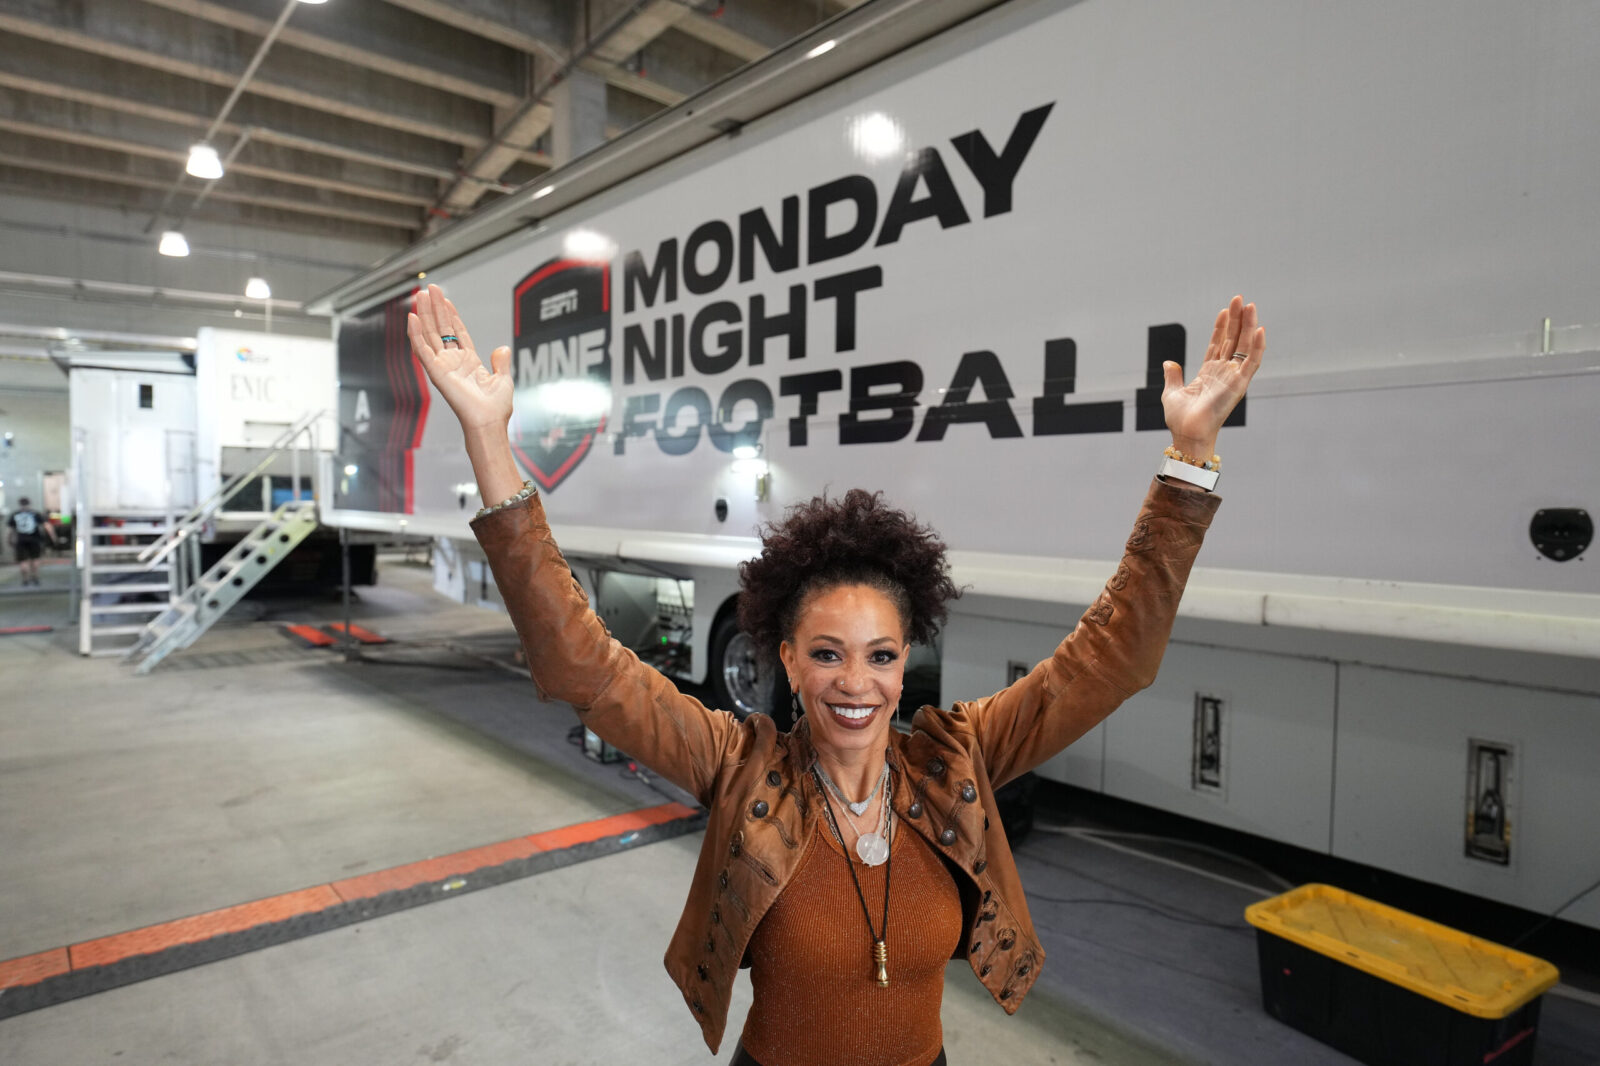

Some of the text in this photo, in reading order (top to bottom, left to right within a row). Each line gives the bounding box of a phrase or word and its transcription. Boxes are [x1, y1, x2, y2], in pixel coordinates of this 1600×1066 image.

[623, 101, 1056, 314] MONDAY
[540, 289, 578, 321] ESPN
[623, 265, 883, 385] NIGHT
[518, 328, 606, 389] MNF
